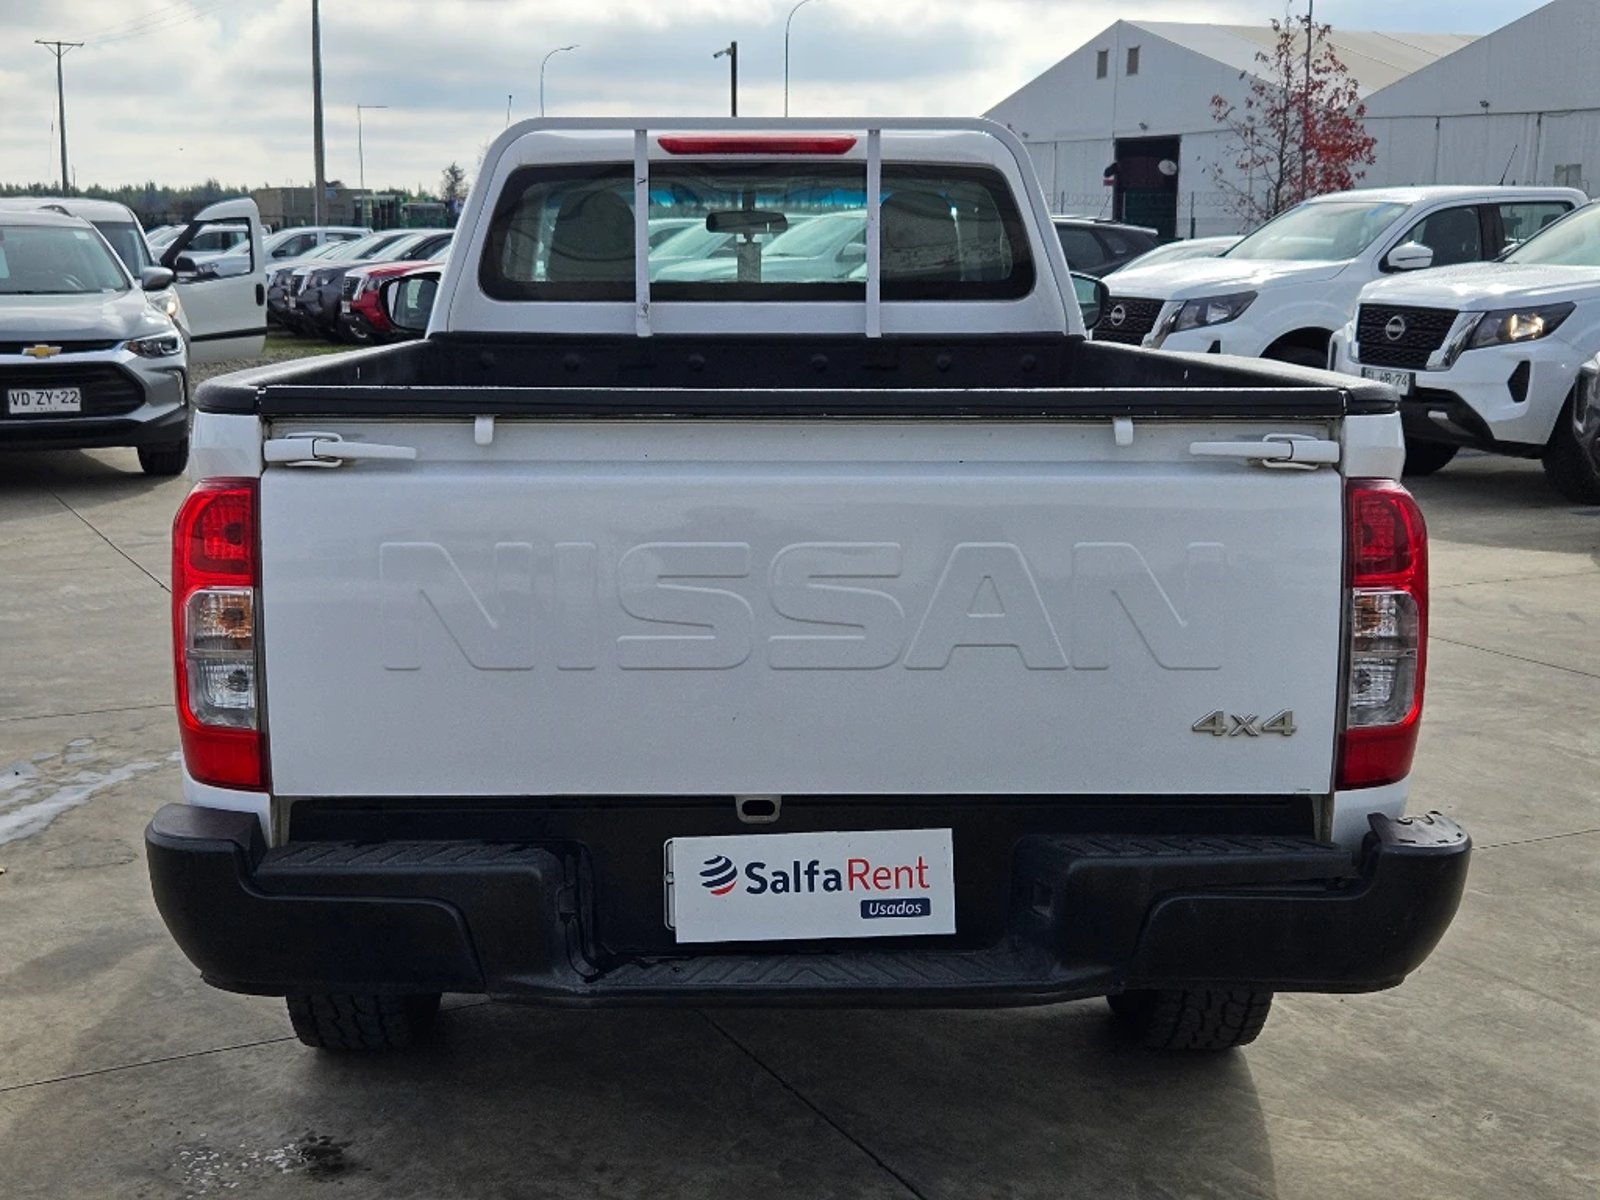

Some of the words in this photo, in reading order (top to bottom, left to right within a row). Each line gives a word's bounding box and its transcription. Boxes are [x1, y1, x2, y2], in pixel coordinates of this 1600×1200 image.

[378, 541, 1225, 671] NISSAN
[1191, 708, 1297, 736] 4x4
[744, 855, 931, 895] SalfaRent
[868, 900, 922, 916] Usados
